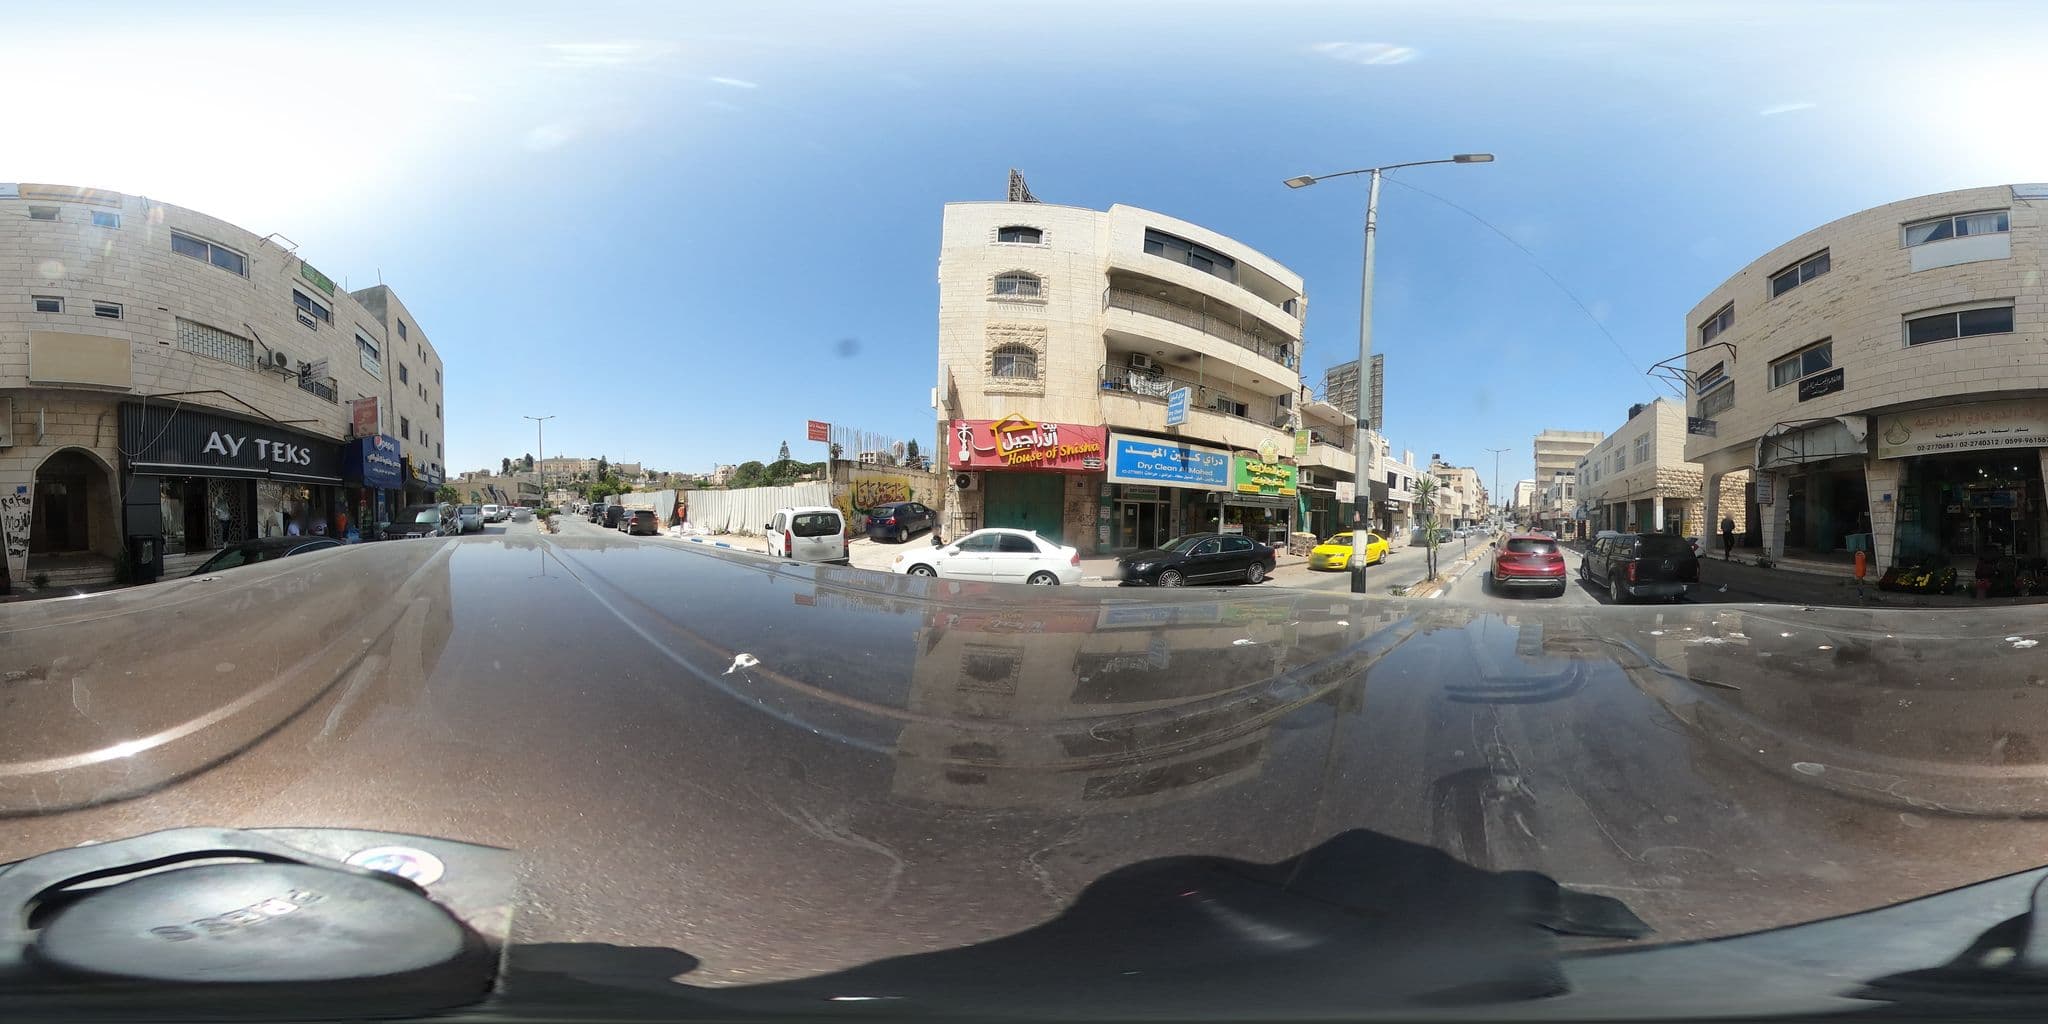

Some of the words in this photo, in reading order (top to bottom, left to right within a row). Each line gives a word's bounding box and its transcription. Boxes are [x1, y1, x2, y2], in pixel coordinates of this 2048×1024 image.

[202, 431, 246, 458] AY
[254, 437, 311, 466] TEKS
[1008, 451, 1042, 465] House
[1046, 447, 1058, 459] of
[1060, 442, 1099, 457] Shisha
[1125, 445, 1167, 459] المهد
[1137, 461, 1153, 471] Dry
[1154, 462, 1177, 472] Clean
[1203, 455, 1223, 467] دراي
[149, 887, 325, 943] PRESS
